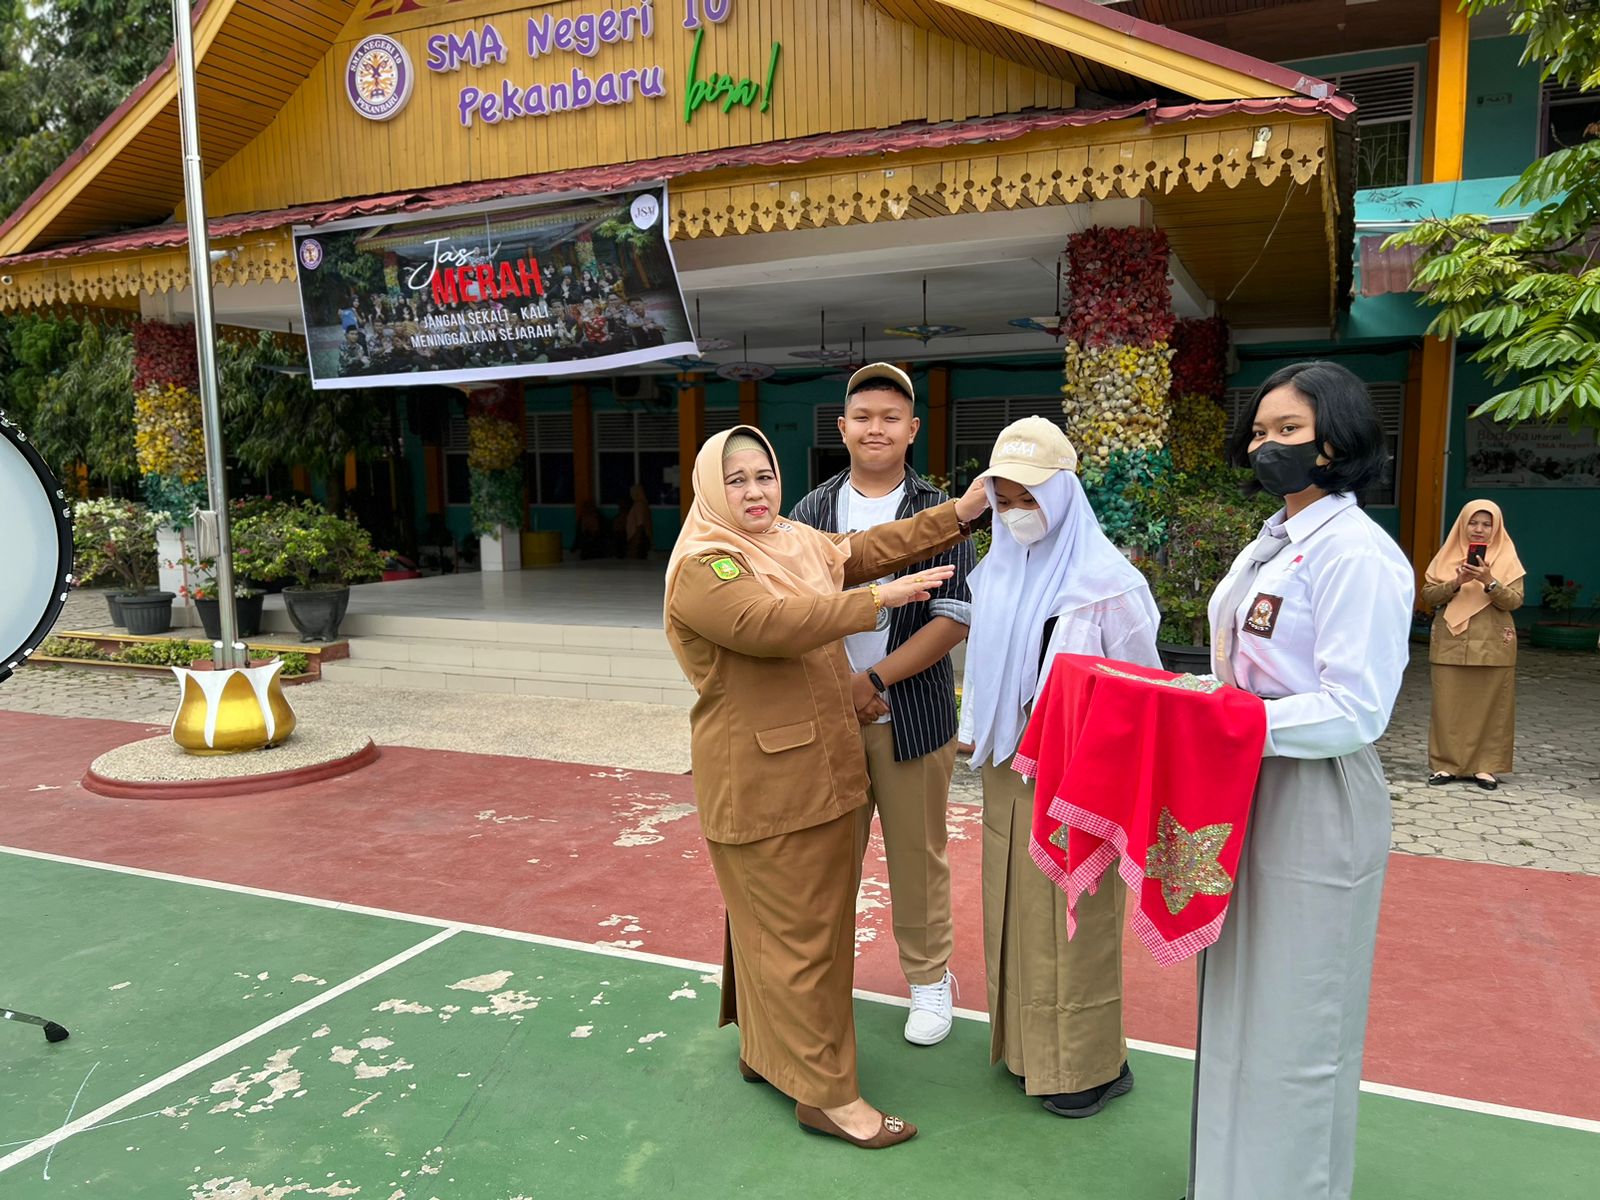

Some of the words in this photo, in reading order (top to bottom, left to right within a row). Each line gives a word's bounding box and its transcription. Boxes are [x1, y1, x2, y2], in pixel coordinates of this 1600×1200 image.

[426, 23, 508, 72] SMA
[527, 0, 654, 58] Negeri
[351, 52, 364, 72] SMA
[363, 41, 395, 55] NEGERI
[393, 54, 402, 64] 10
[356, 93, 399, 113] PEKANBARU
[458, 65, 666, 127] Pekanbaru
[408, 237, 476, 290] Jas
[430, 258, 545, 305] MERAH
[410, 327, 498, 349] MENINGGALKAN
[499, 324, 553, 342] SEJARAH
[423, 312, 465, 329] JANGAN
[467, 308, 509, 325] SEKALI
[520, 305, 550, 320] KALI
